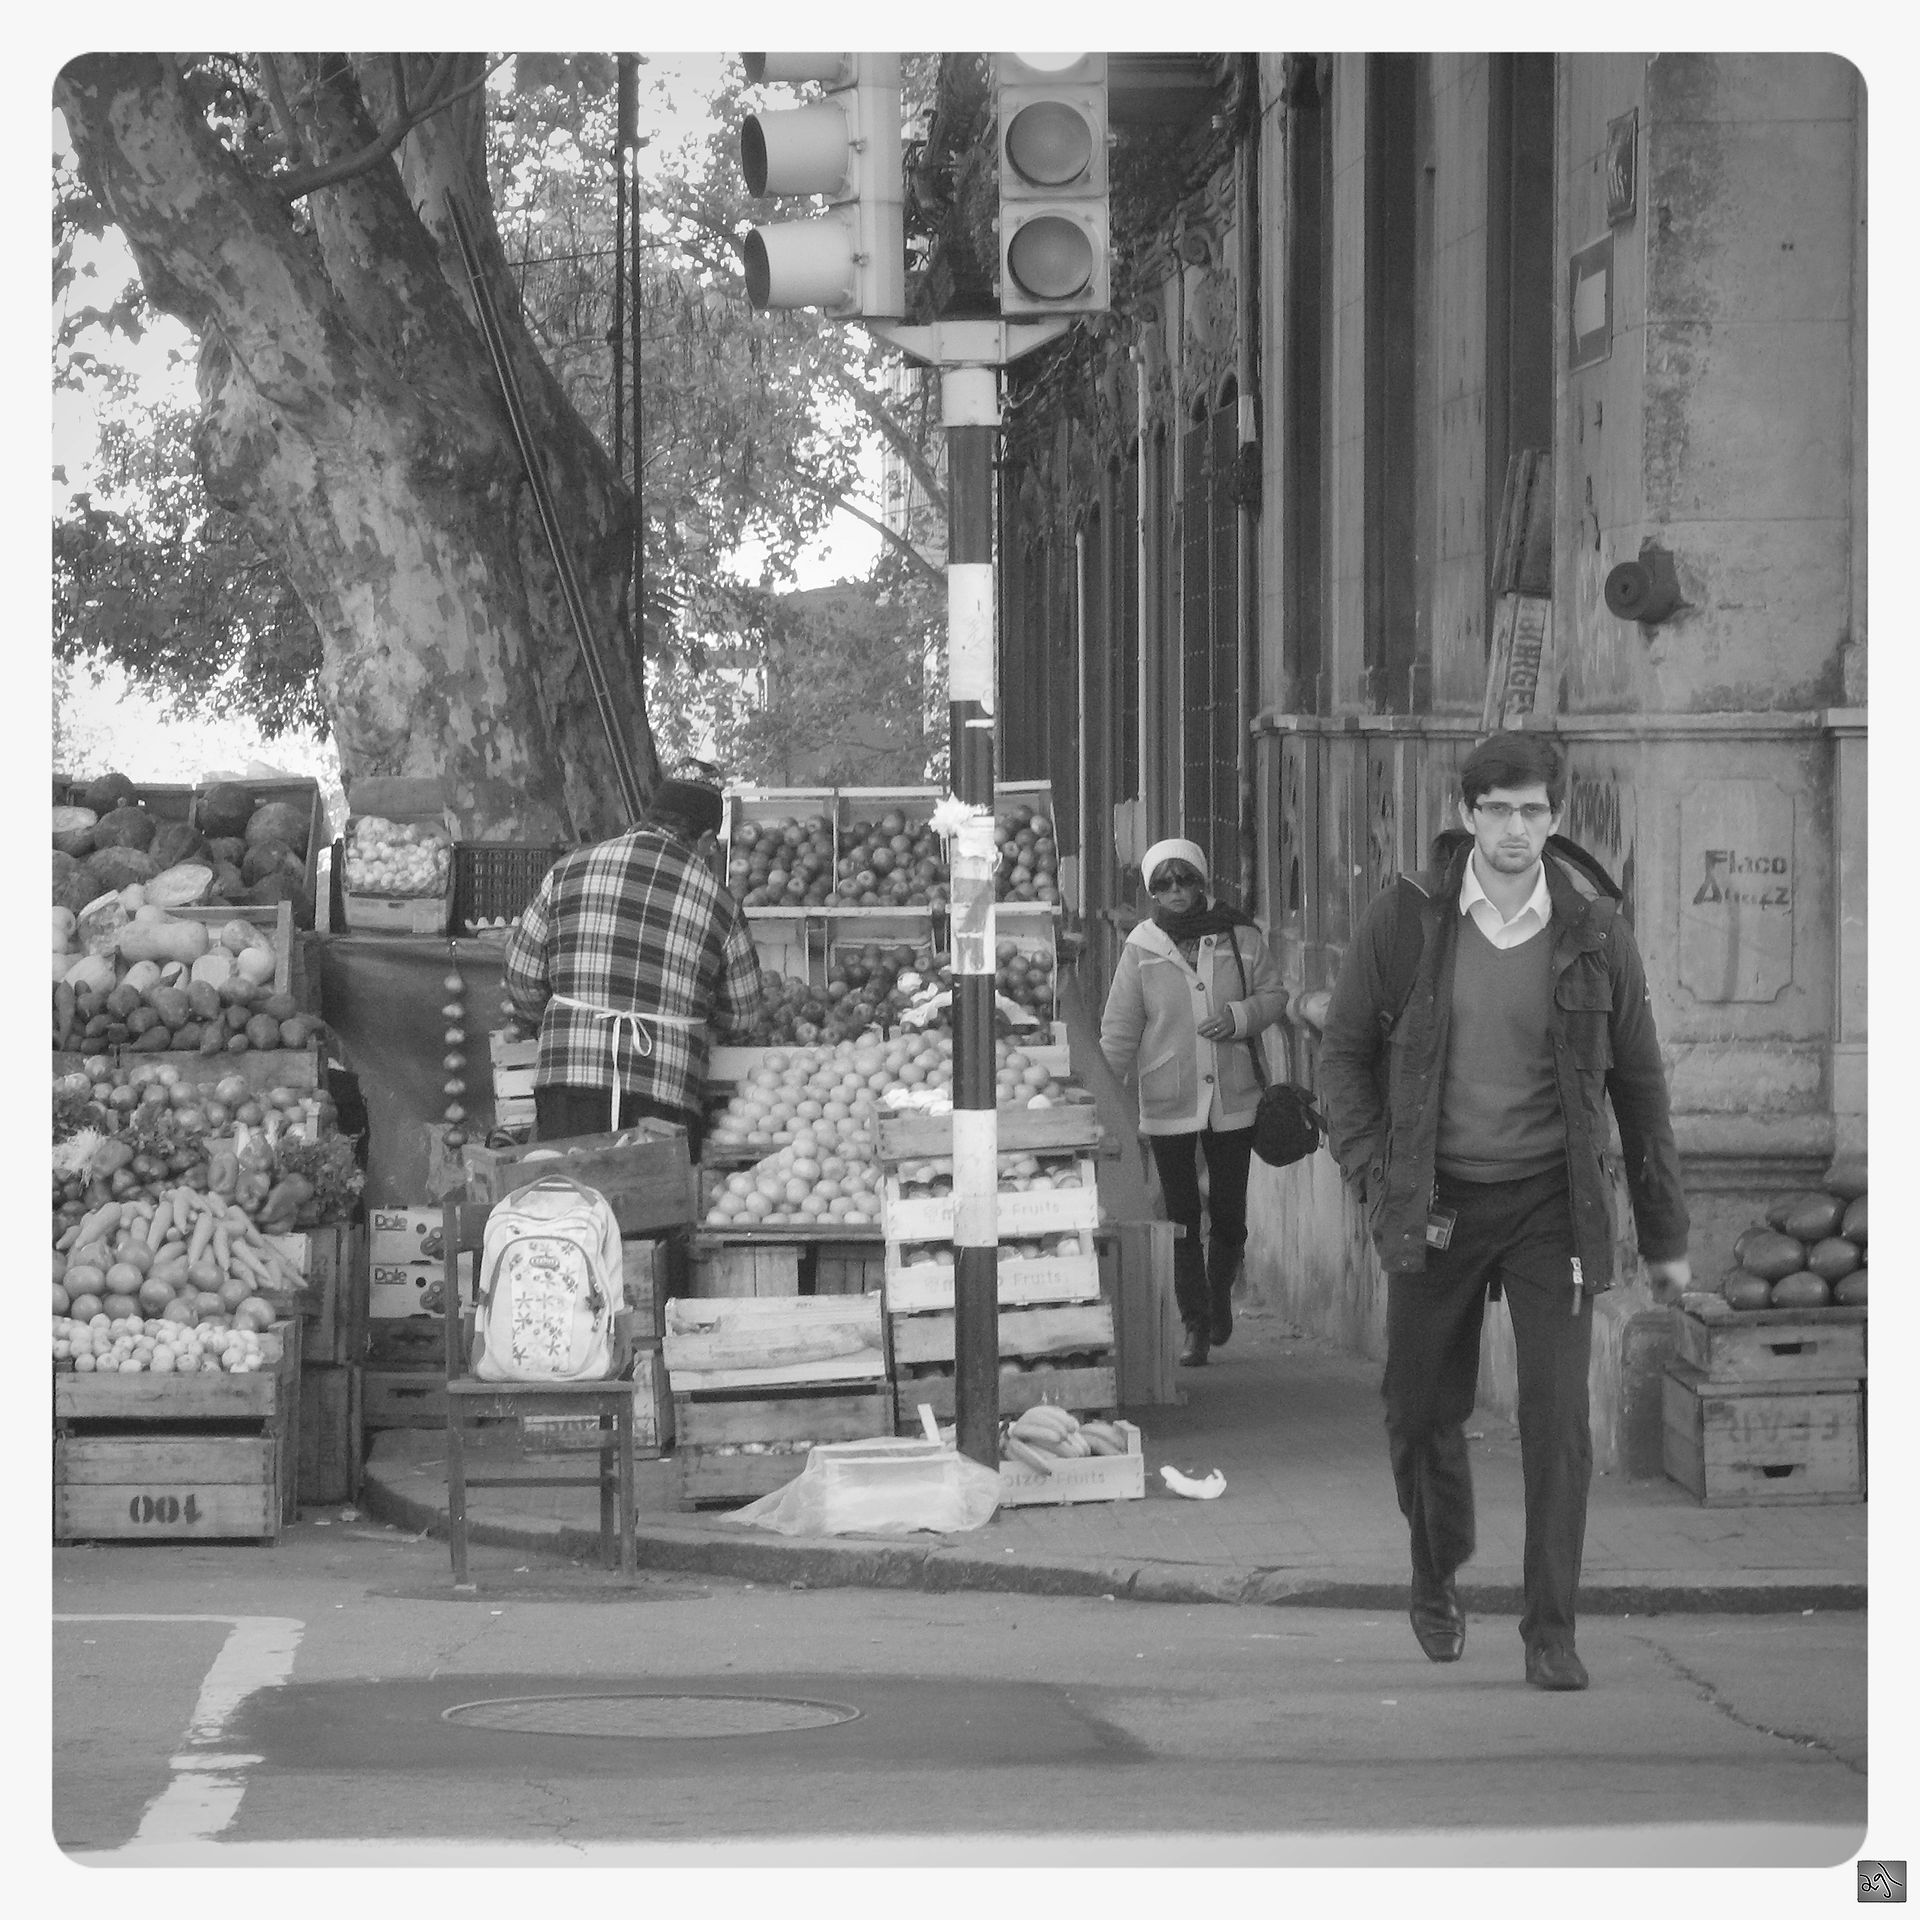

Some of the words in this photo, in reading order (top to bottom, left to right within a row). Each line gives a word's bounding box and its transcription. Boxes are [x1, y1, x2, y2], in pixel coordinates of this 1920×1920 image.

[1705, 850, 1788, 875] Flaco
[375, 1213, 408, 1228] Dole
[375, 1267, 408, 1281] Dole
